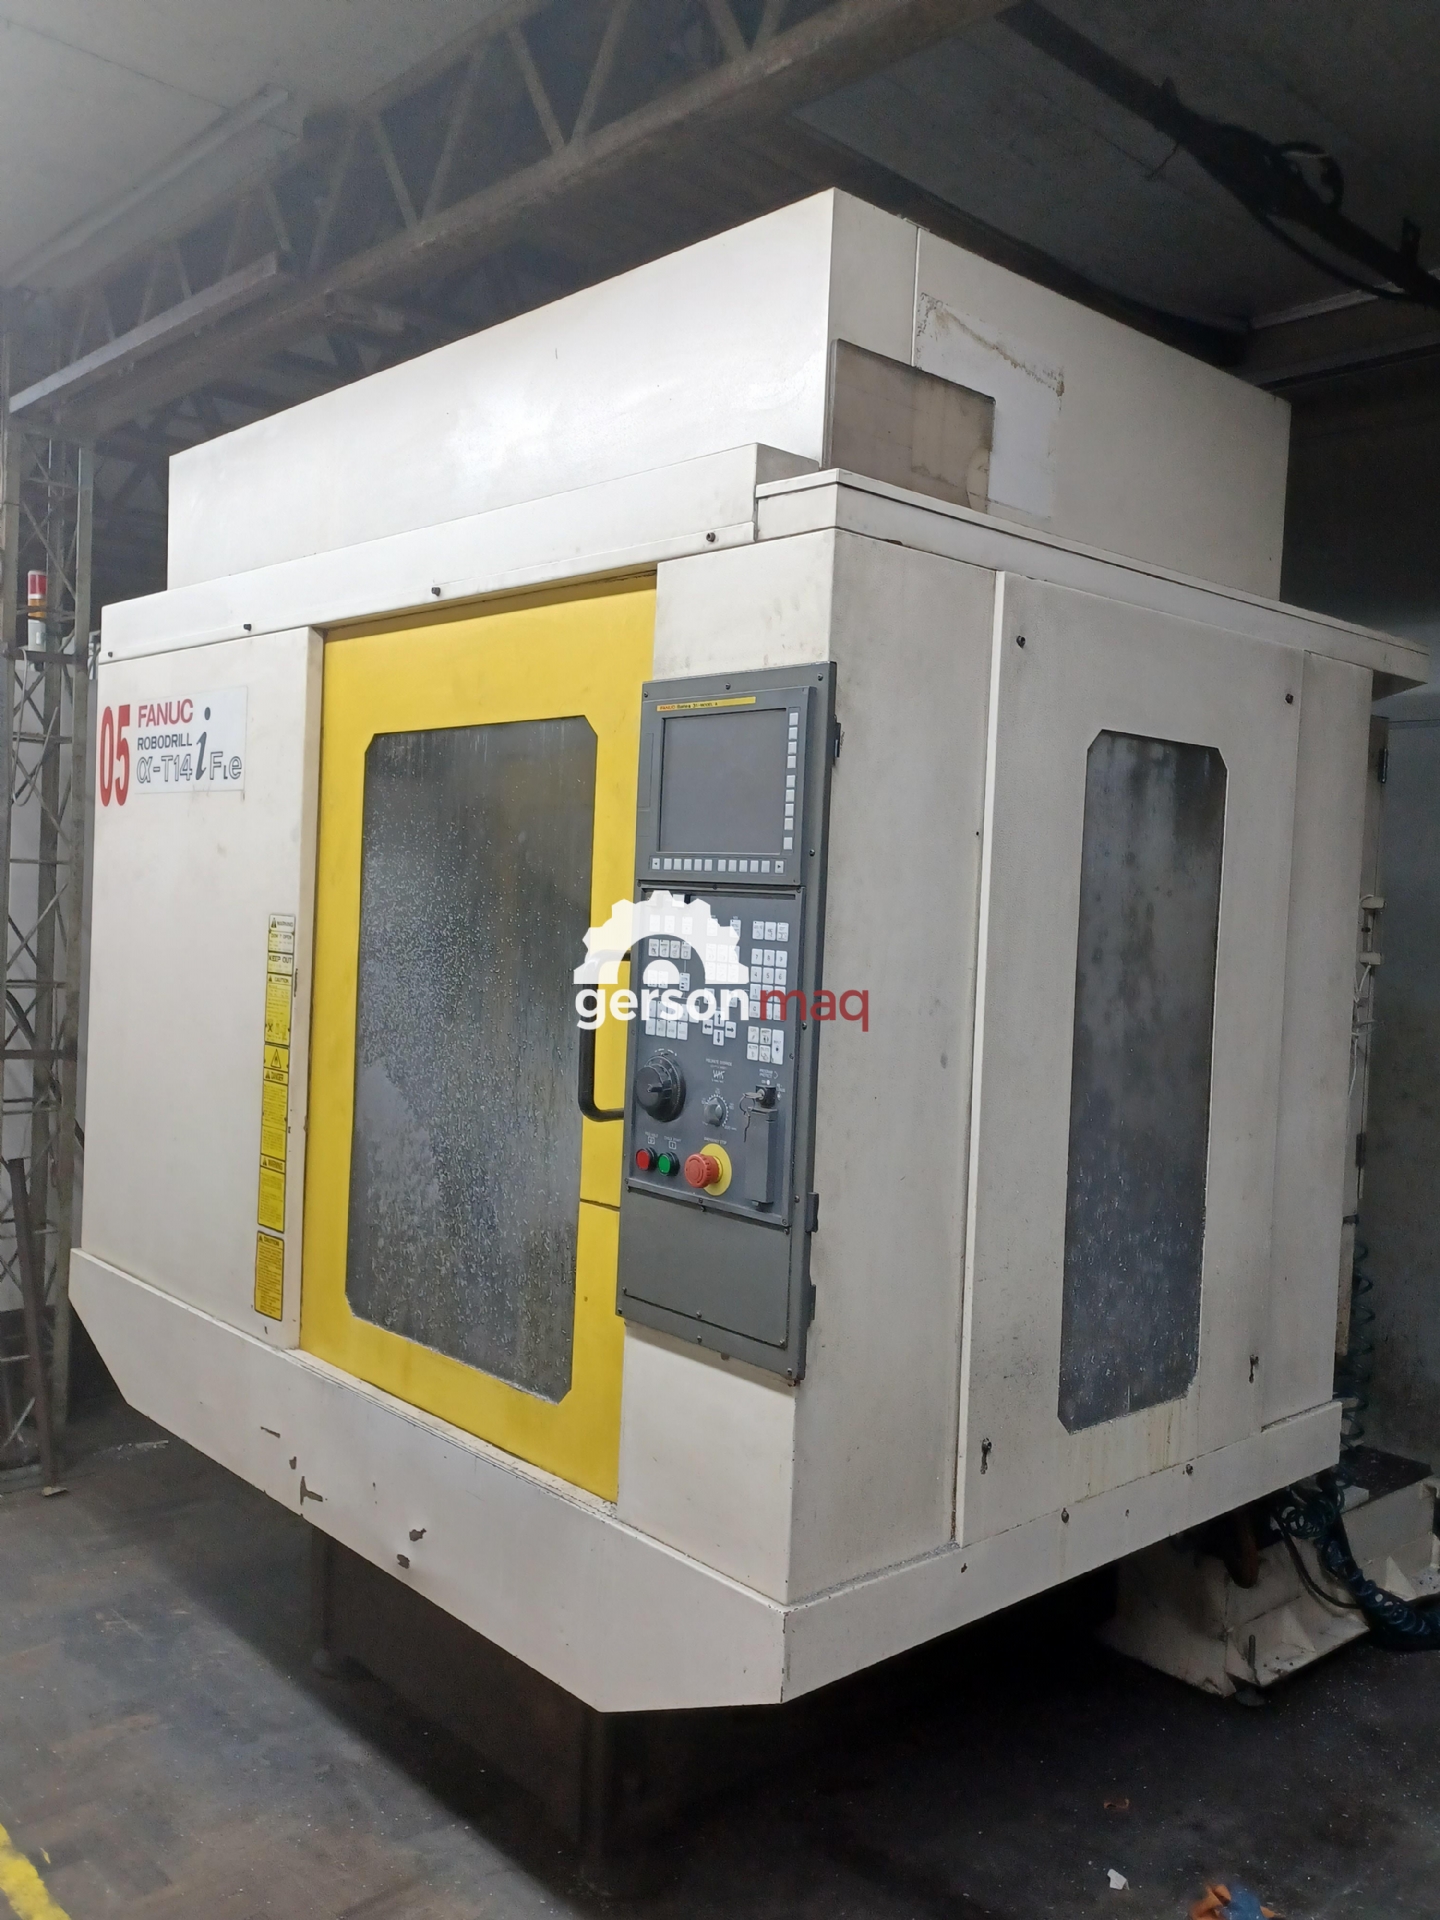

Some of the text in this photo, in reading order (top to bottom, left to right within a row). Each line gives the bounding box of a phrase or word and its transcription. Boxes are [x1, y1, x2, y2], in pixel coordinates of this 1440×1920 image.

[138, 699, 193, 728] FANUC
[100, 704, 131, 807] 05
[137, 733, 192, 750] ROBODRILL
